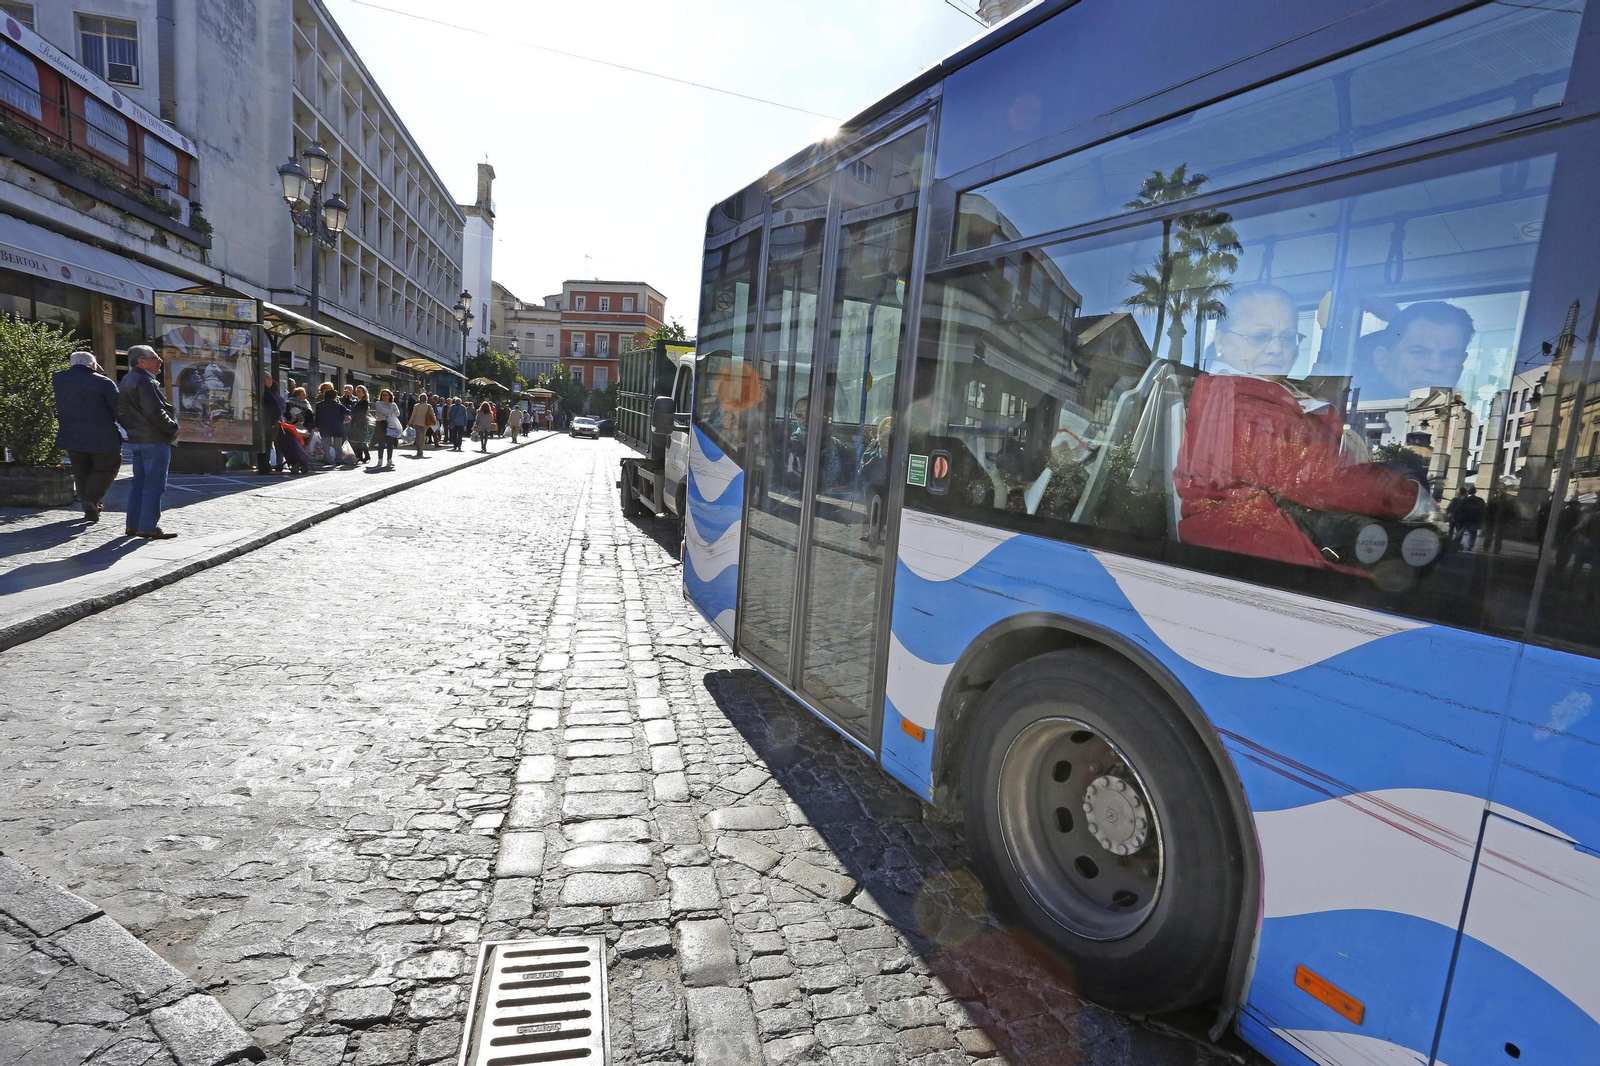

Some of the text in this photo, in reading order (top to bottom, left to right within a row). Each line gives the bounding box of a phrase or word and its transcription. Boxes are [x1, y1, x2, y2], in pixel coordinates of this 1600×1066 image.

[38, 42, 89, 84] Restaurante
[0, 249, 48, 272] BERTOLA
[320, 338, 345, 358] Vanessa
